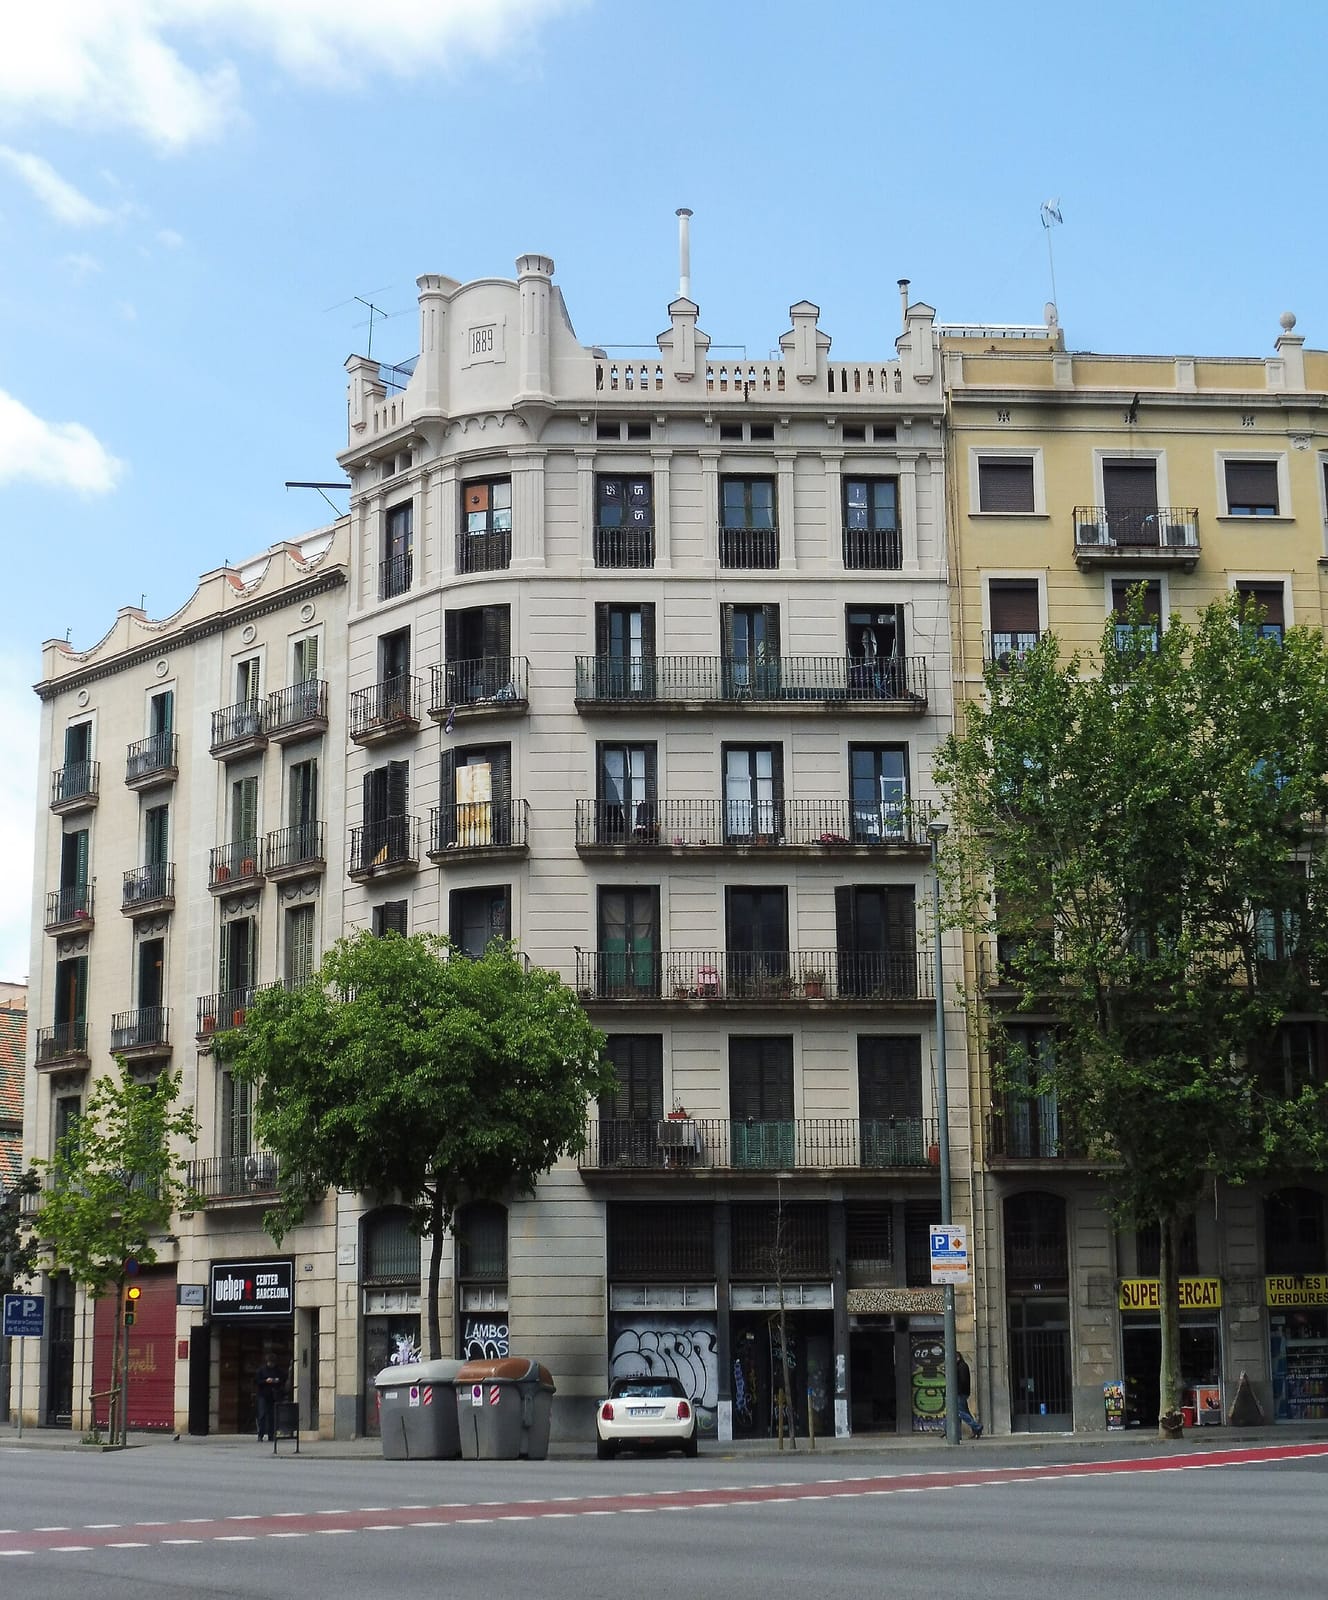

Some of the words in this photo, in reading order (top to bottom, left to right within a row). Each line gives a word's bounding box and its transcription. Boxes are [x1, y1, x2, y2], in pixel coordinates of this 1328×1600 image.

[472, 329, 493, 354] 1889
[935, 1236, 945, 1249] P
[215, 1274, 245, 1301] weber
[256, 1274, 278, 1286] CENTER
[1269, 1277, 1321, 1290] FRUITES
[256, 1287, 289, 1300] BARCELONA
[1122, 1282, 1218, 1306] SUPEERCAT
[1270, 1292, 1328, 1304] VERDURES
[22, 1299, 37, 1317] P
[465, 1319, 509, 1340] LAMBO
